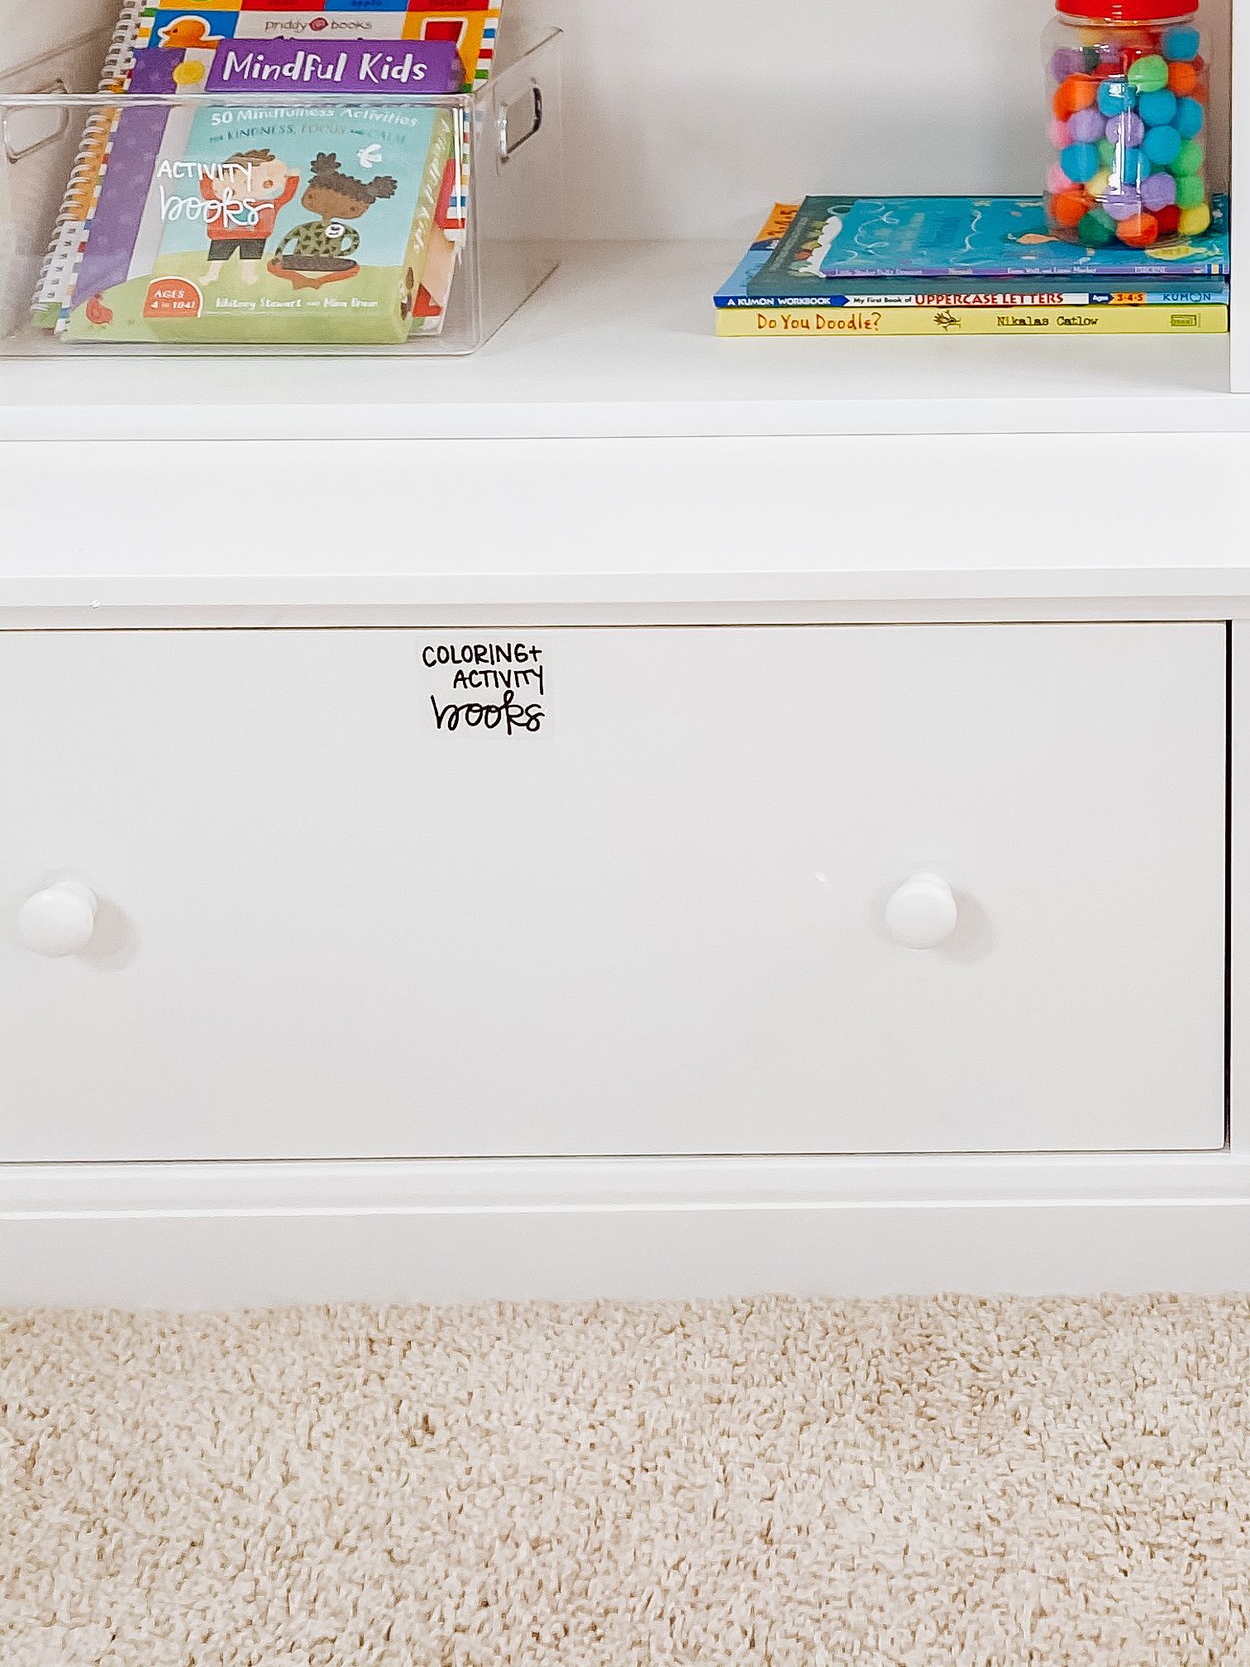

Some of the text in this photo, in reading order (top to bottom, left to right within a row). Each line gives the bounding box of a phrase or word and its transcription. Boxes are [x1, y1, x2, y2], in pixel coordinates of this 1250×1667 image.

[265, 20, 372, 33] priddy books
[222, 50, 427, 84] Mindful Kids
[157, 159, 253, 191] ACTIVITY
[159, 185, 274, 228] books
[727, 297, 831, 306] A KUMON WORKBOOK
[915, 293, 1064, 306] UPPERCASE LETTERS
[757, 312, 881, 331] Do You Doodle?
[997, 316, 1099, 327] Nikalas Catlow
[422, 643, 543, 668] COLORING+
[453, 665, 544, 695] ACTIVITY
[430, 689, 545, 735] books
